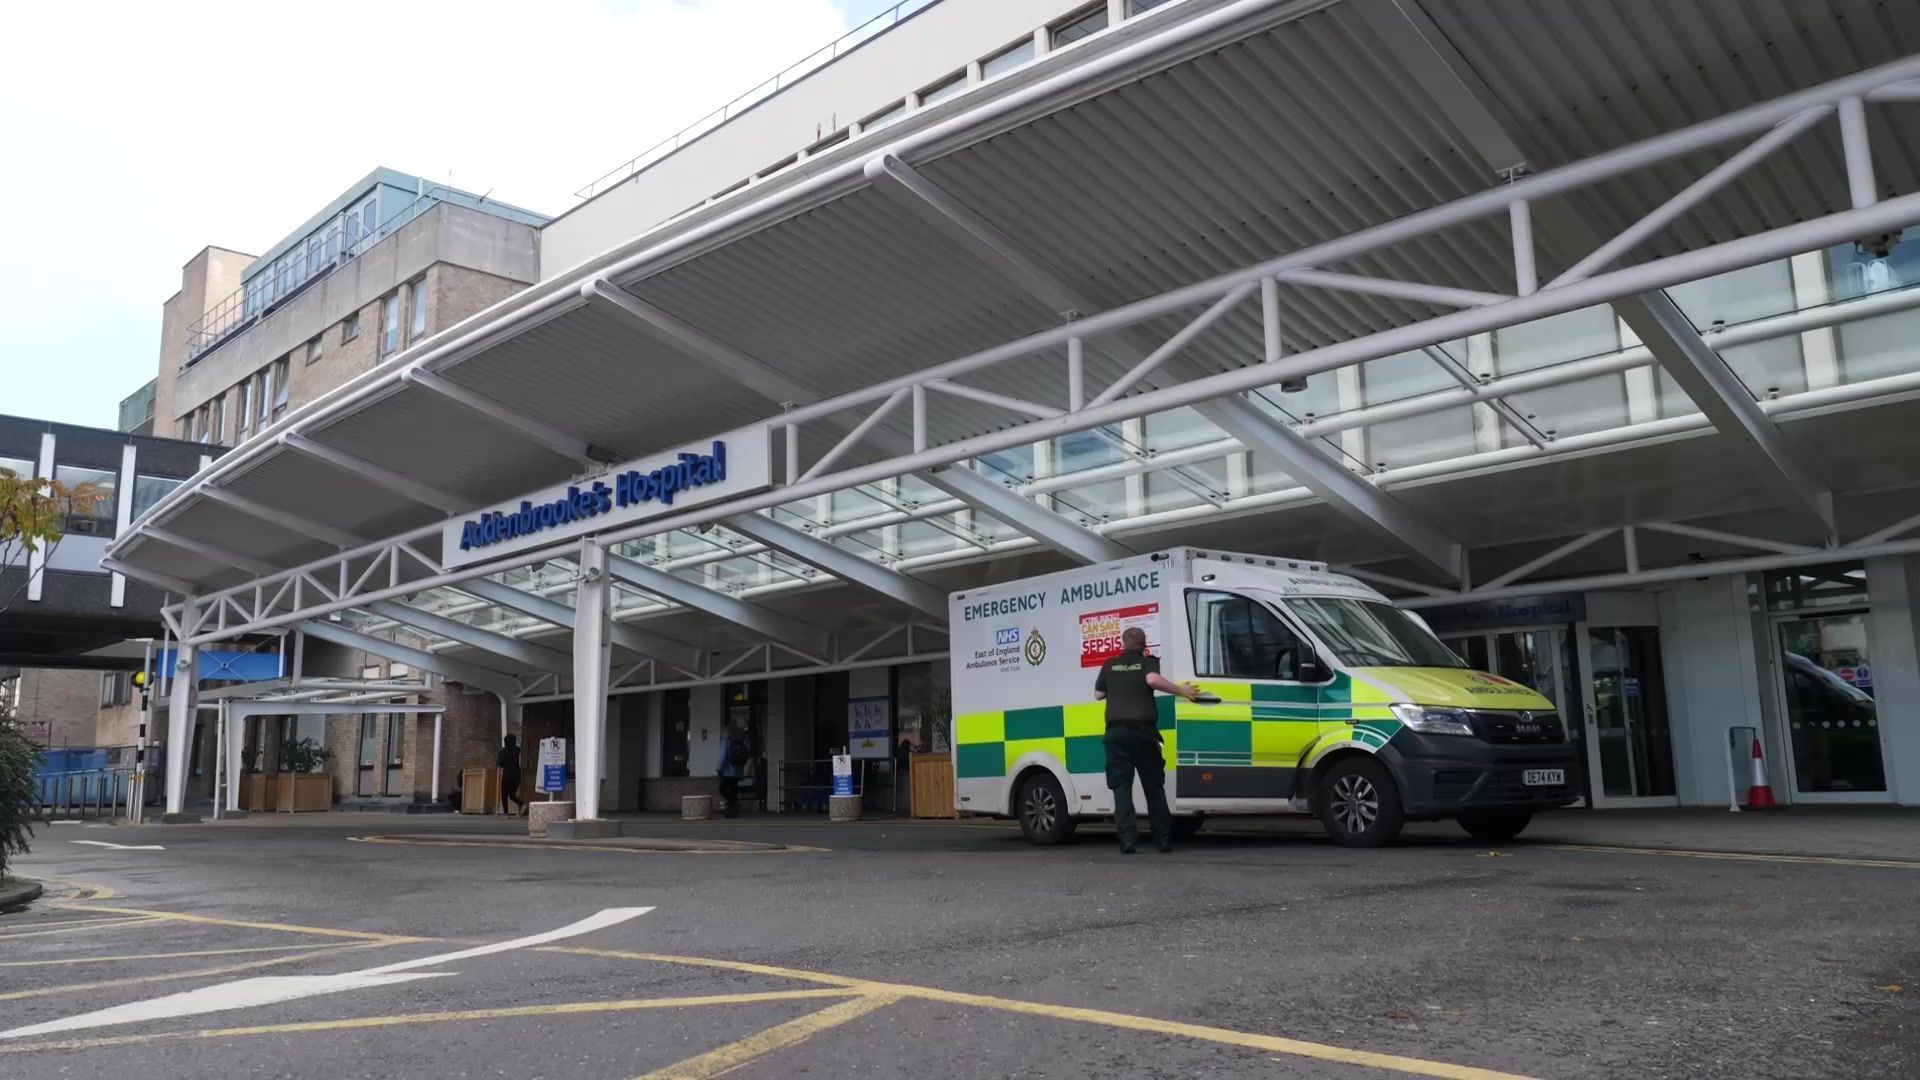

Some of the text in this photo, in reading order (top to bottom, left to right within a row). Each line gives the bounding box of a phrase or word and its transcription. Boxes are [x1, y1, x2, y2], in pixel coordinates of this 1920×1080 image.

[459, 440, 726, 551] Addenbrooke's Hospital
[964, 571, 1160, 621] EMERGENCY AMBULANCE
[1081, 624, 1099, 634] CAN
[1100, 620, 1120, 631] SAVE
[997, 629, 1019, 643] NHS
[975, 644, 1020, 659] East of England
[1083, 636, 1122, 654] SEPSIS
[966, 656, 1020, 669] Ambulance Service
